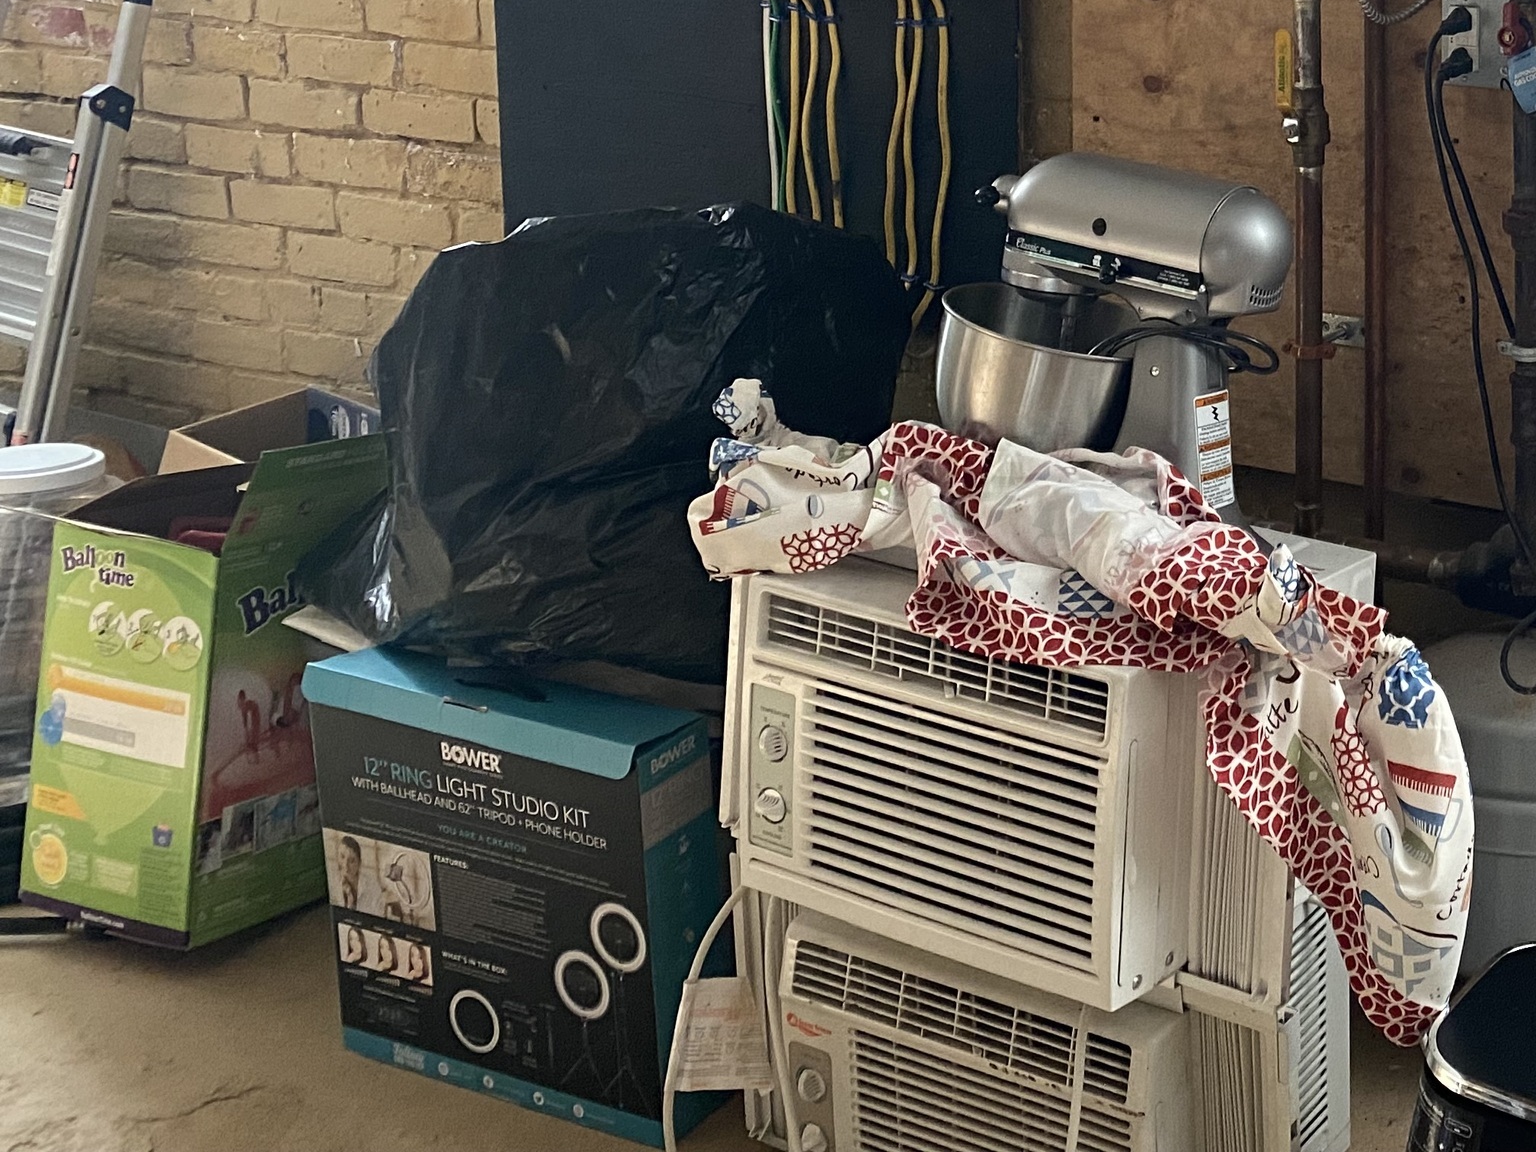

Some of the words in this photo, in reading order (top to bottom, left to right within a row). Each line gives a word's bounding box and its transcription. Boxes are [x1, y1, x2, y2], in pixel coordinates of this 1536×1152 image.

[61, 544, 126, 573] Balloon
[98, 567, 135, 588] time
[441, 741, 501, 774] BOWER
[650, 735, 696, 774] BOWER
[351, 776, 379, 792] WITH
[380, 782, 432, 805] BALLHEAD
[433, 796, 457, 812] AND
[477, 806, 516, 827] TRIPOD
[524, 818, 563, 839] PHONE
[563, 828, 607, 850] HOLDER
[389, 762, 433, 790] RING
[436, 774, 487, 802] LIGHT
[491, 787, 559, 821] STUDIO
[562, 805, 590, 829] KIT
